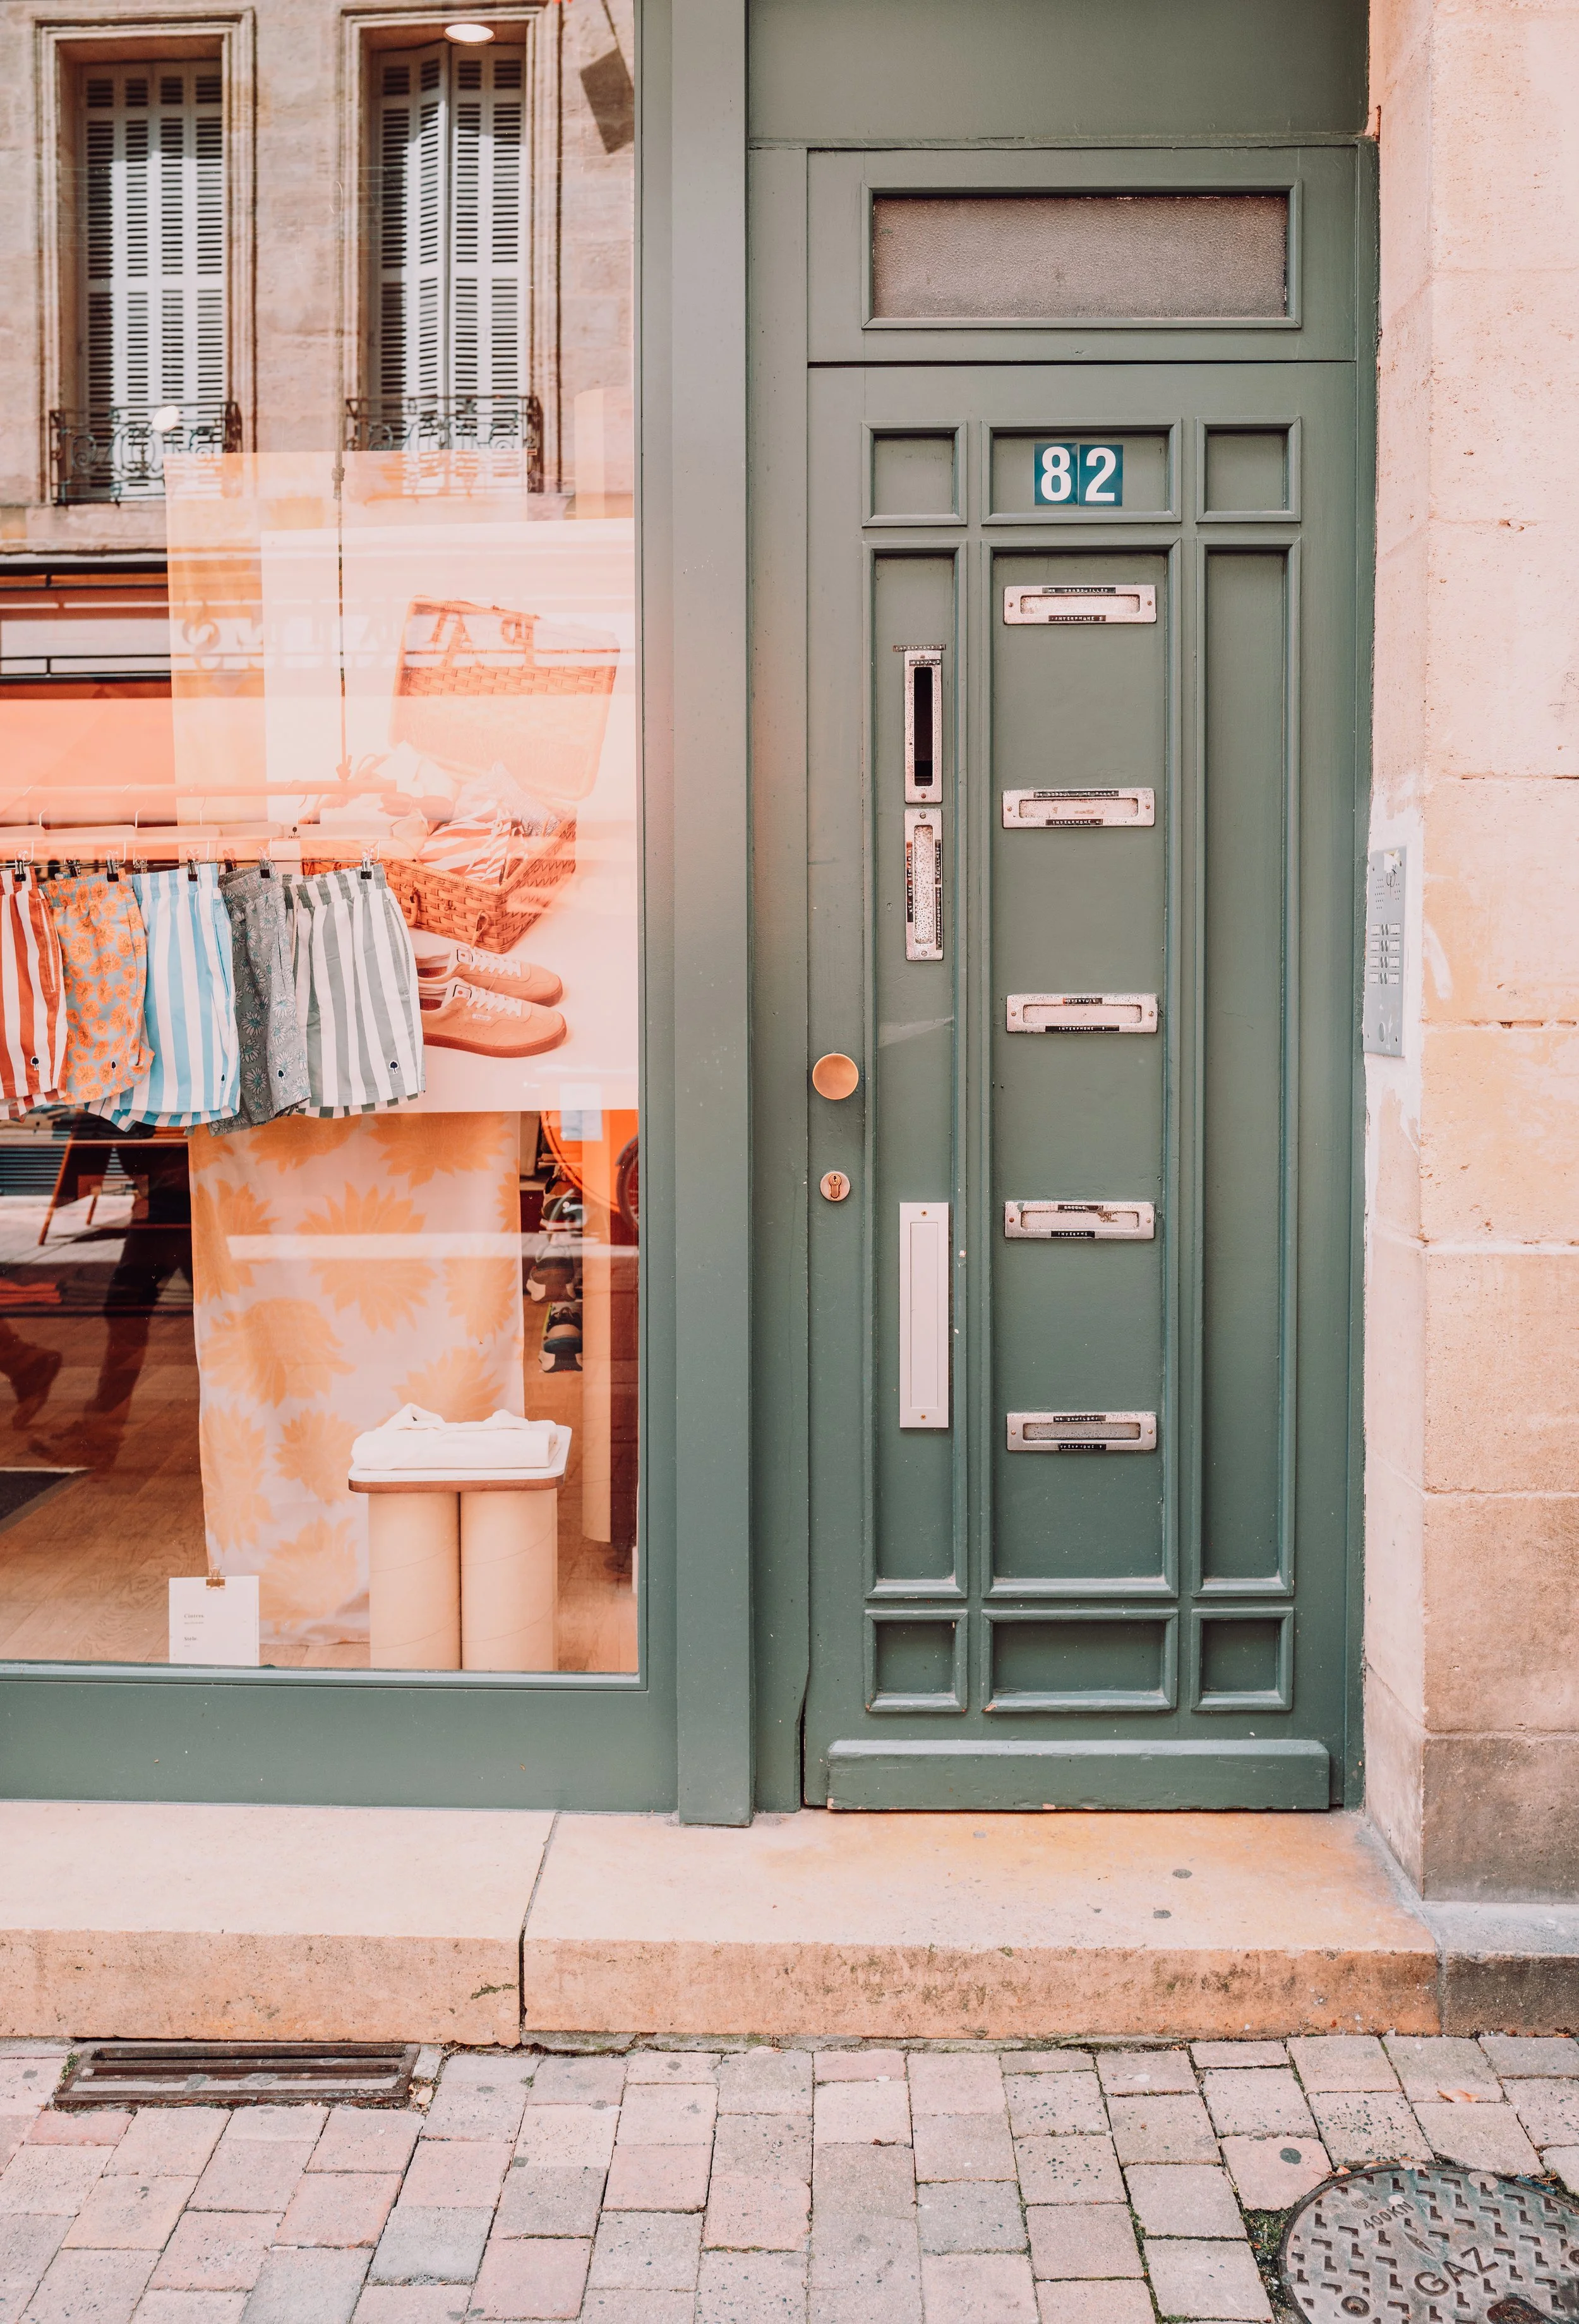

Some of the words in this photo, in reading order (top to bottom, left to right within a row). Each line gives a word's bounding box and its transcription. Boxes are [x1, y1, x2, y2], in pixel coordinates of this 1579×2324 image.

[1040, 446, 1117, 502] 82
[1362, 2201, 1415, 2230] 400KN
[1414, 2246, 1499, 2297] GAZ
